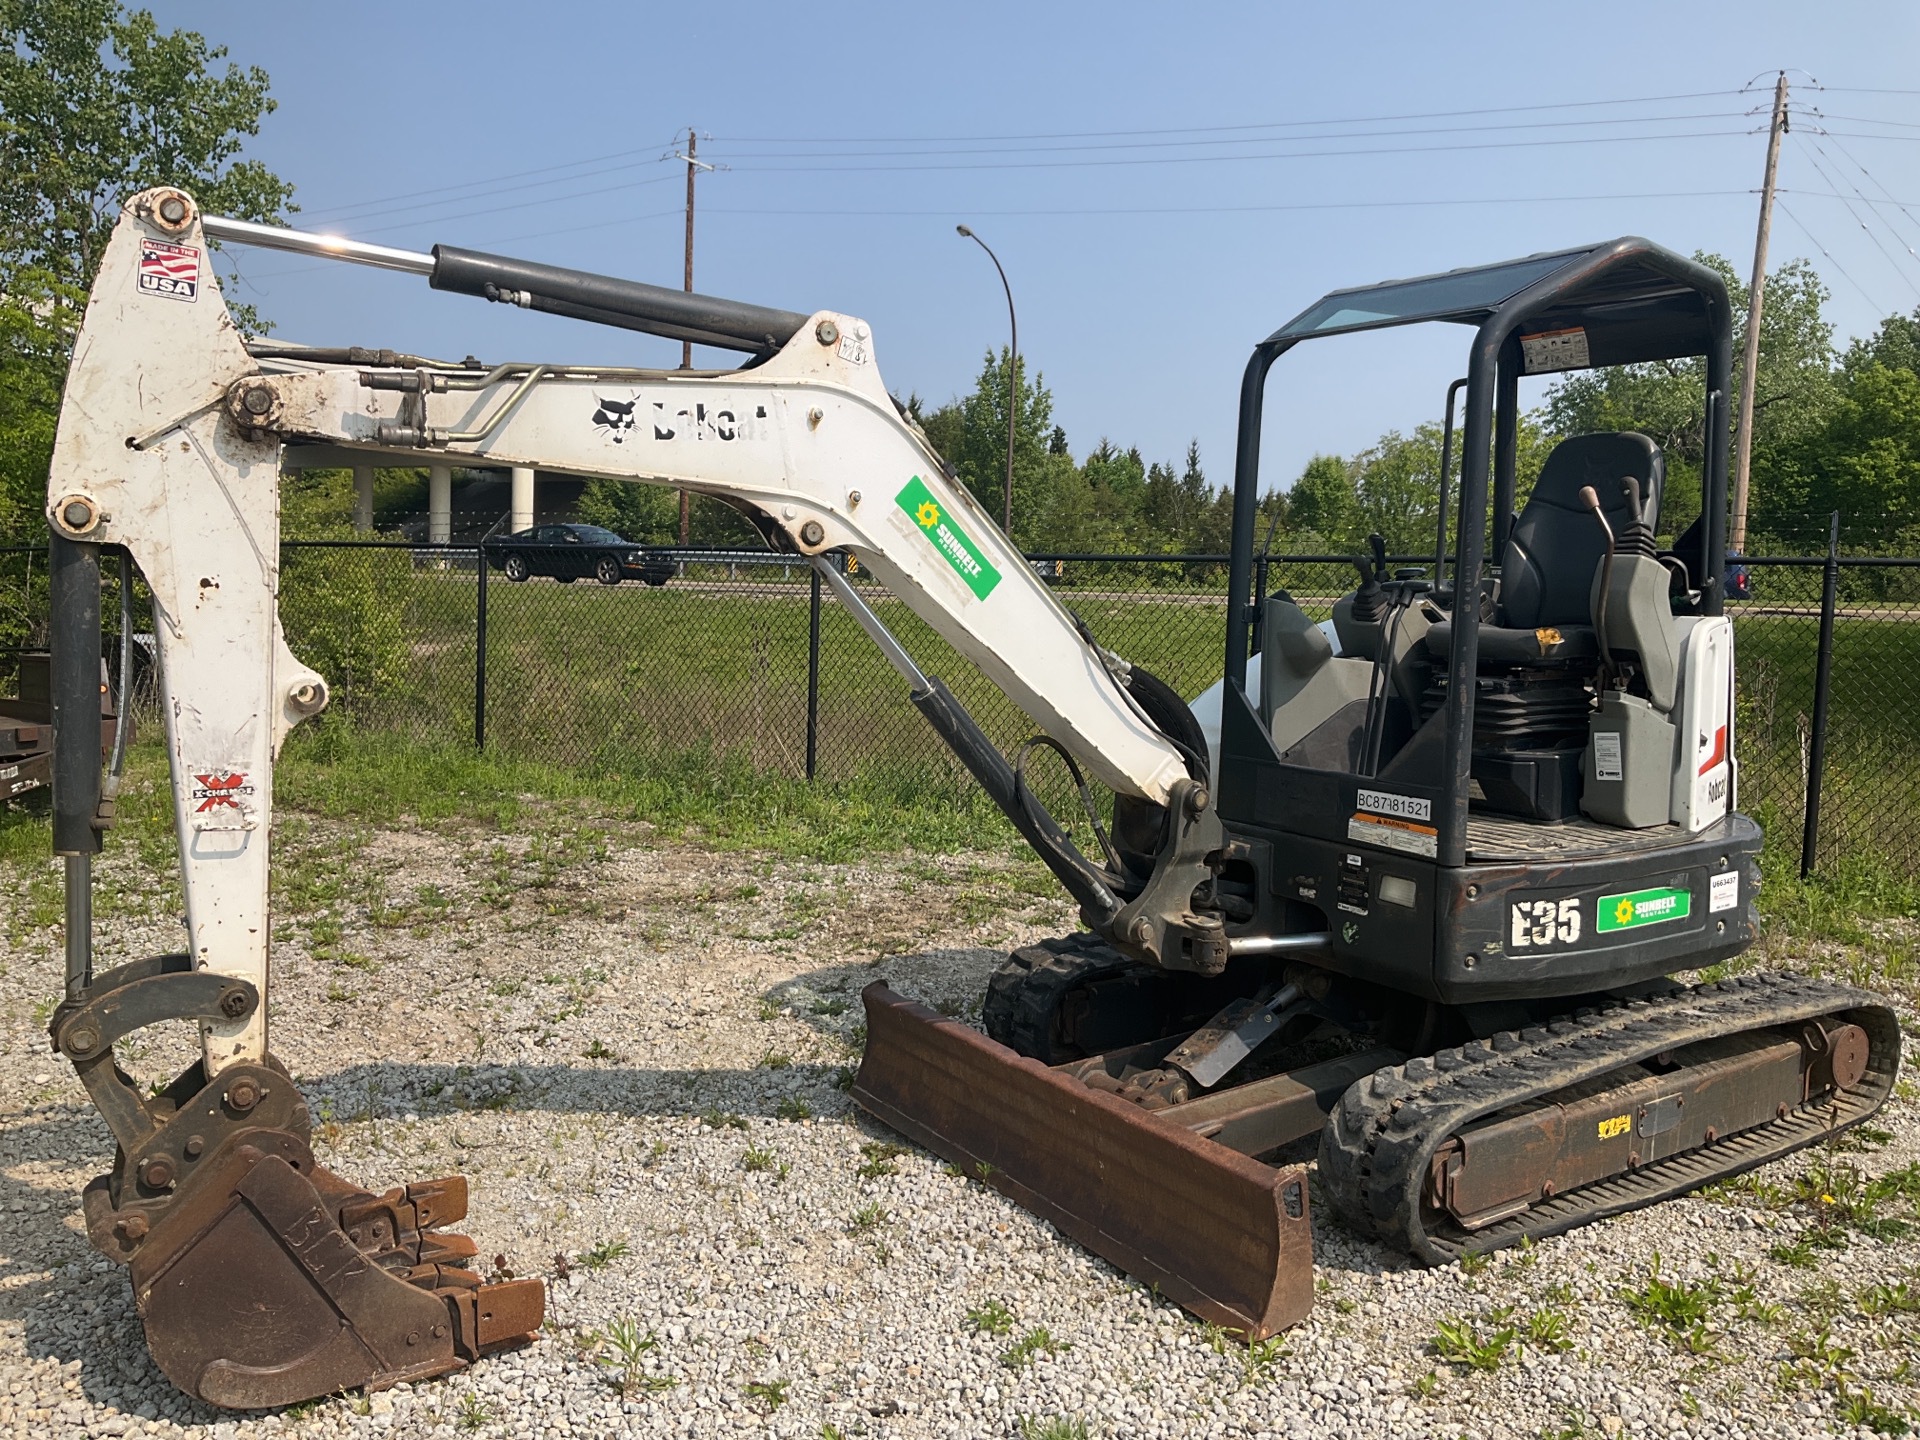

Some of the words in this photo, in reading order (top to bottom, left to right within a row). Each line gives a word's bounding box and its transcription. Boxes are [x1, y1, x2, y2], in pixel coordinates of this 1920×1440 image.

[144, 241, 169, 252] MADE
[180, 248, 195, 256] THE
[142, 275, 192, 296] USA
[936, 523, 982, 576] SUNBELT
[938, 538, 969, 574] RENTALS
[1383, 820, 1410, 830] WARNING
[1712, 876, 1736, 889] U663437
[1635, 895, 1677, 915] SUNBELT
[1640, 908, 1671, 919] RENTALS
[1511, 898, 1581, 947] E35
